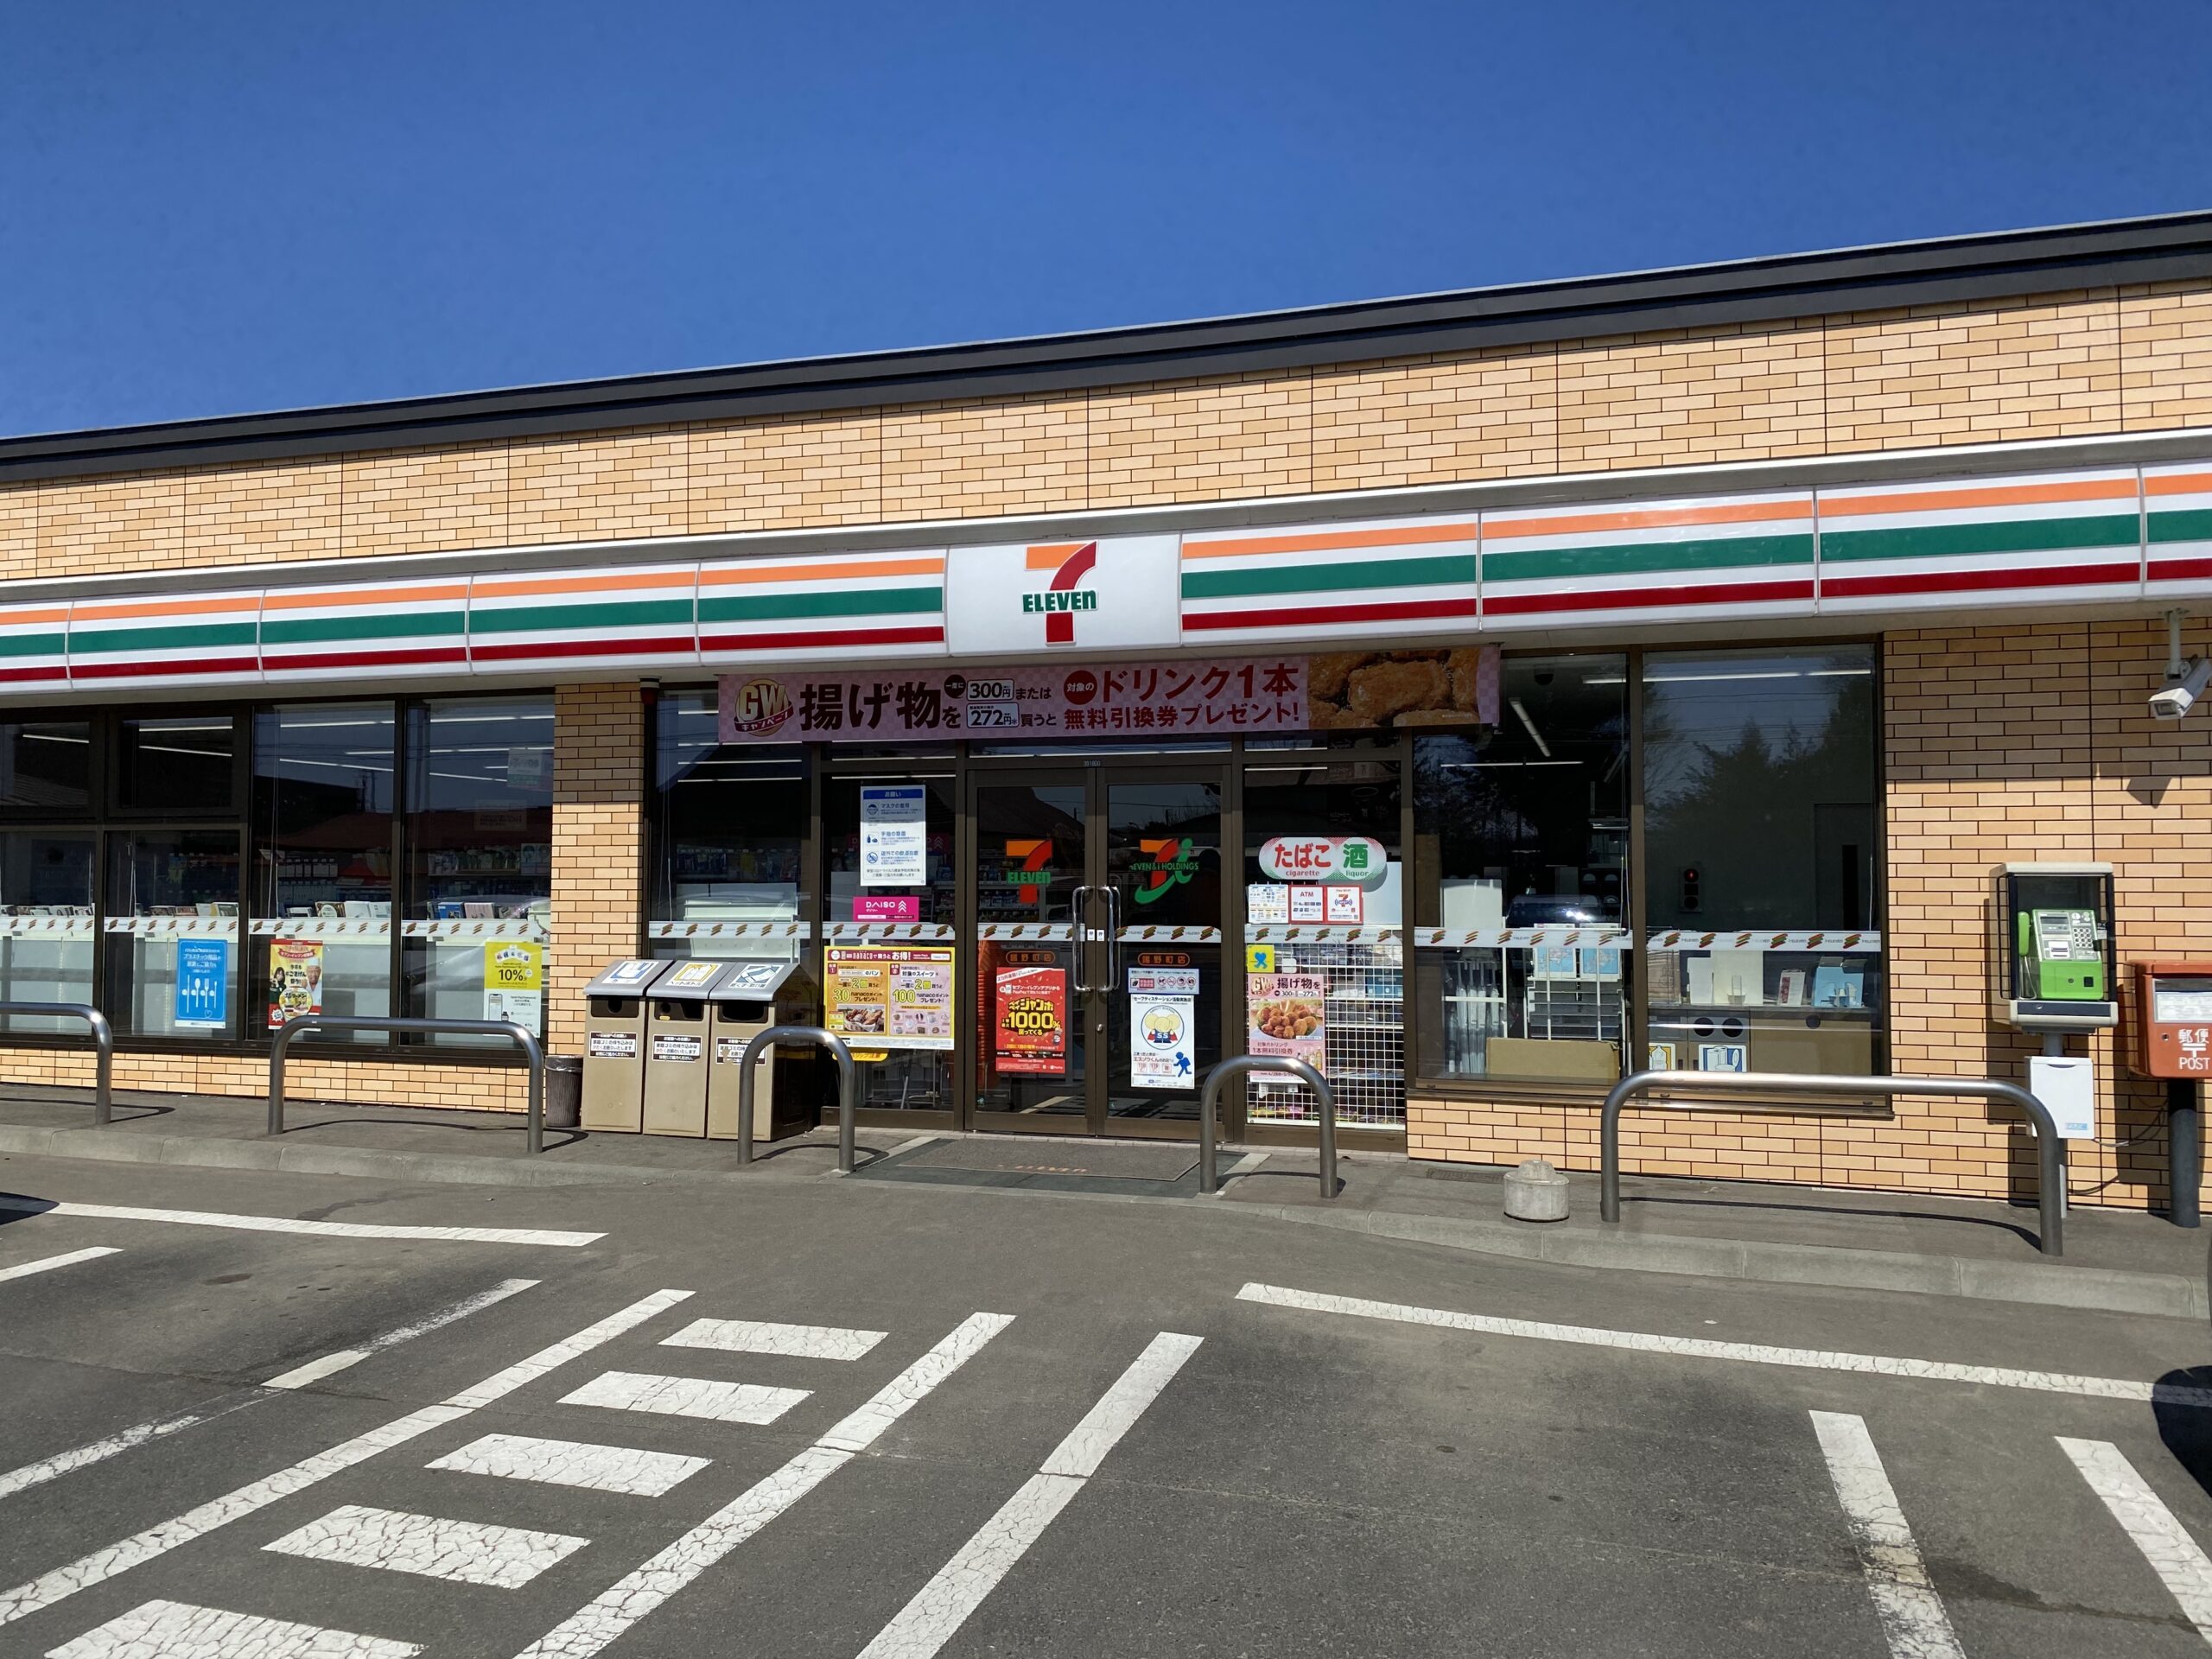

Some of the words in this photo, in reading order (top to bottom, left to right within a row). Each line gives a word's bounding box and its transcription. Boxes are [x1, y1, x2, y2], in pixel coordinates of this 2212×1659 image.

[1066, 680, 1095, 693] 対象の
[1103, 662, 1299, 703] ドリンク1本
[969, 682, 1011, 699] 300円
[1015, 687, 1052, 701] または
[739, 683, 788, 721] GW
[800, 681, 961, 731] 揚げ物を
[741, 713, 791, 732] キャンペーン
[1020, 713, 1057, 728] 買うと
[1274, 842, 1332, 868] たばこ
[1343, 843, 1369, 869] 酒
[1161, 861, 1199, 871] HOLDINGS
[1285, 869, 1320, 878] cigarette
[1345, 869, 1370, 878] liquor
[499, 969, 524, 982] 10%
[1277, 977, 1320, 989] 揚げ物を
[833, 988, 850, 1002] 30
[893, 989, 915, 1003] 100
[1008, 1012, 1061, 1029] 1000%
[2177, 1027, 2209, 1044] 郵便
[2178, 1057, 2211, 1070] POST
